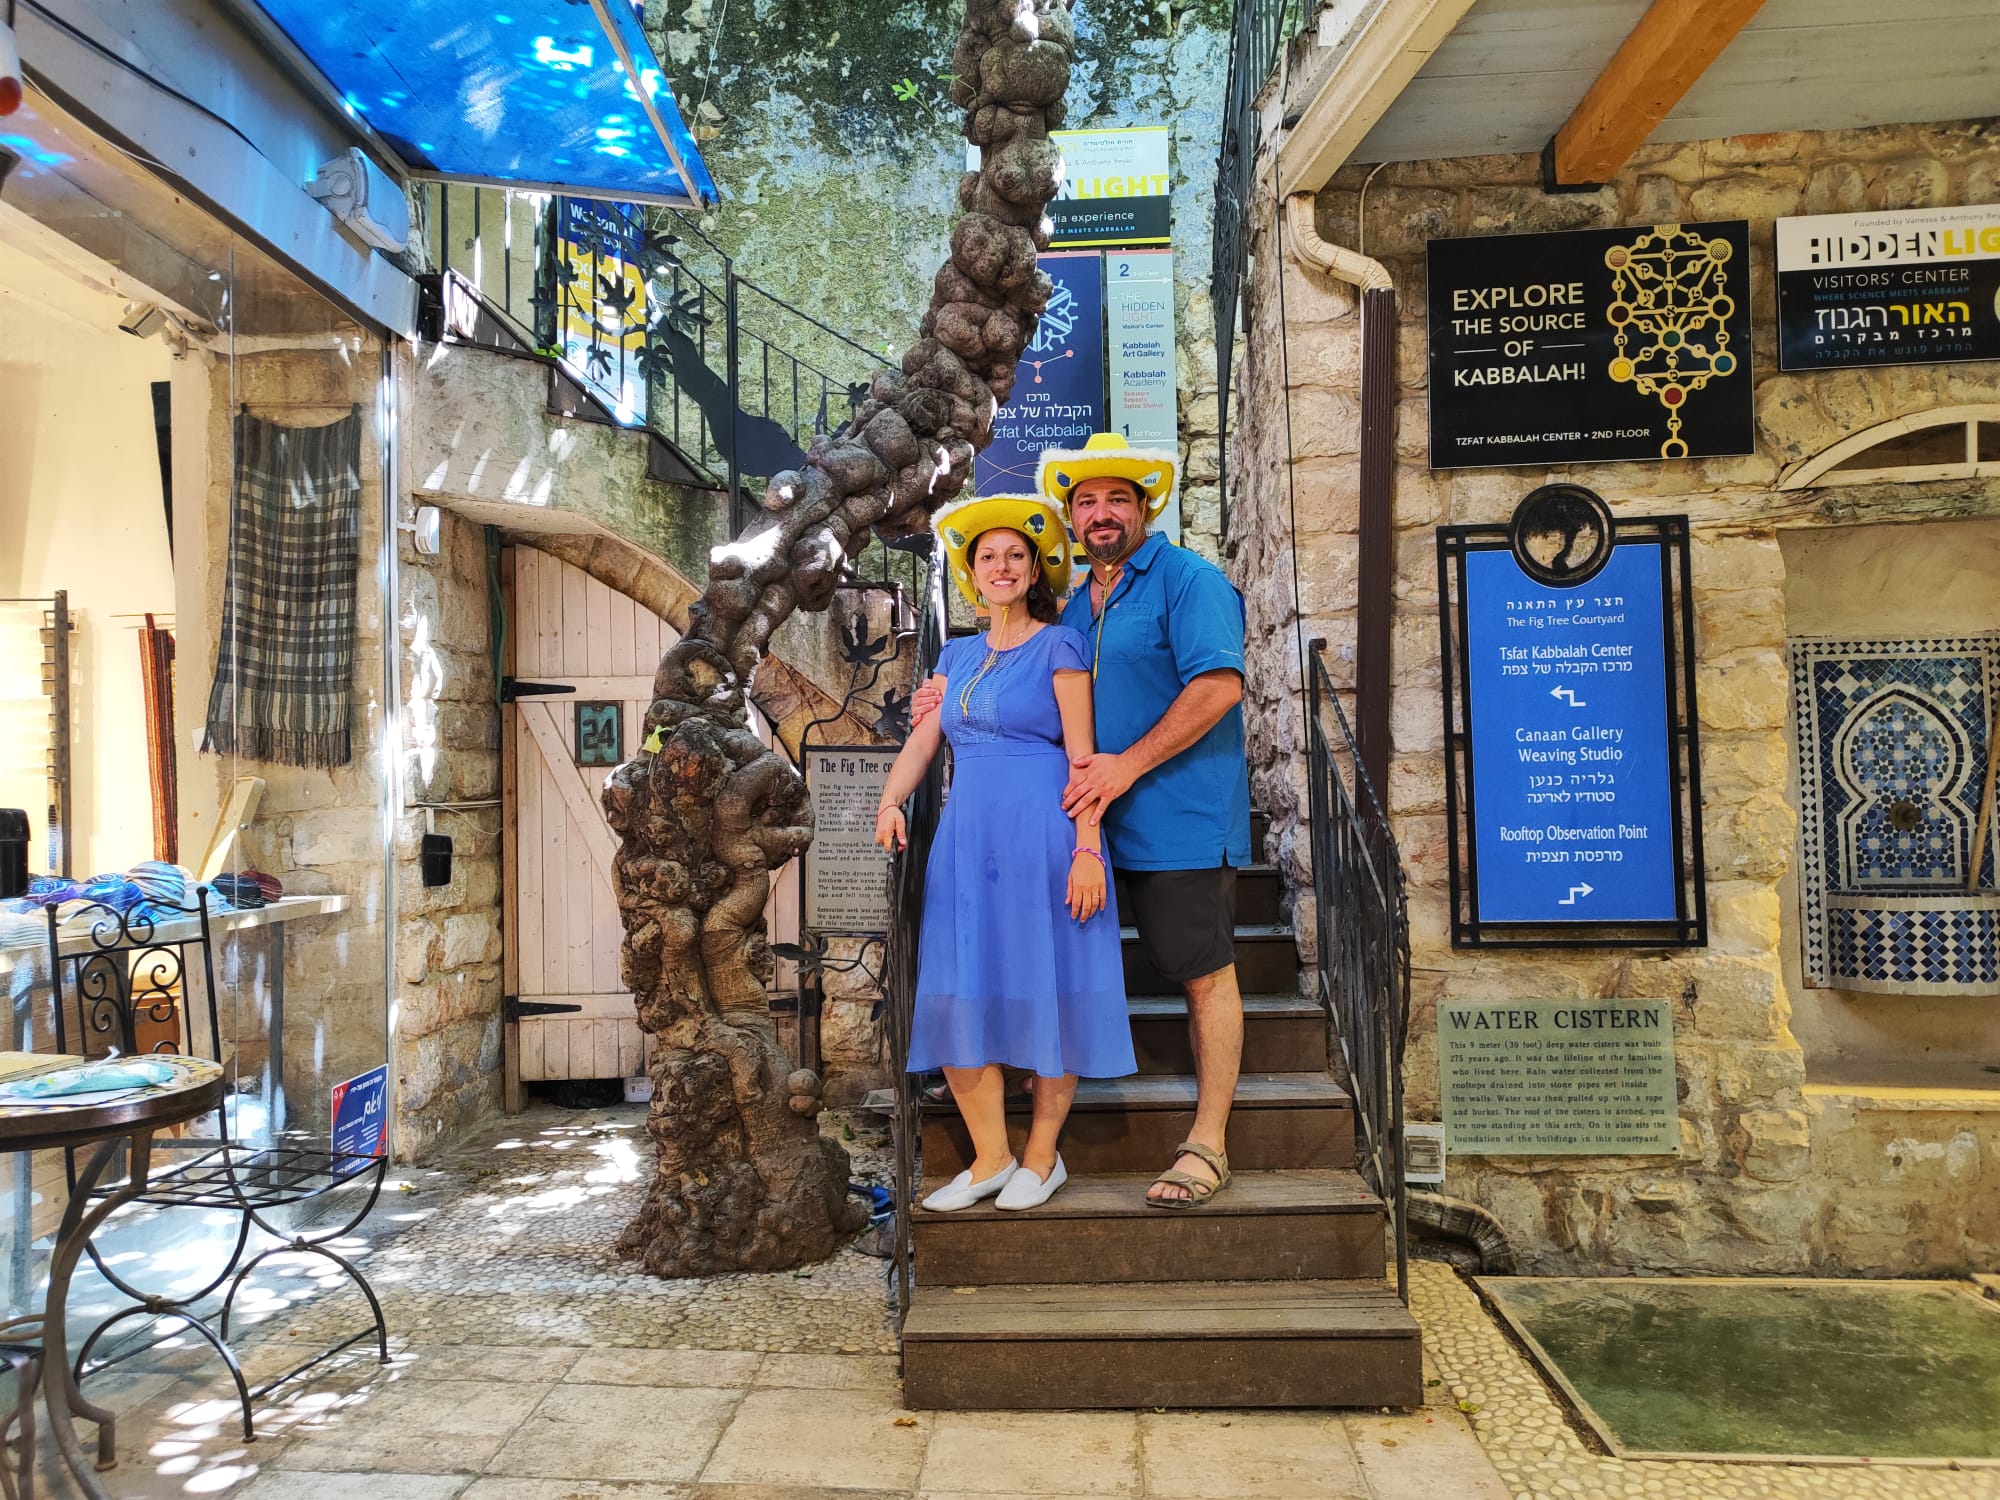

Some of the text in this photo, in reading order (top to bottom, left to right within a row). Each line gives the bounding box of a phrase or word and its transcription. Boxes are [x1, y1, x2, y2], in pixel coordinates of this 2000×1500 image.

[1071, 211, 1135, 224] experience
[1854, 219, 1891, 228] Founded
[1892, 217, 1903, 226] by
[1905, 215, 1938, 225] Vanessa
[1949, 212, 1983, 223] Anthony
[1119, 263, 1130, 277] 2
[1901, 268, 1969, 284] CENTER
[1452, 282, 1585, 312] EXPLORE
[1814, 286, 1970, 302] WHERE SCIENCE MEETS KABBALAH
[1121, 301, 1165, 312] HIDDEN
[1122, 312, 1156, 322] LIGHT
[1451, 312, 1586, 336] THE SOURCE
[1814, 327, 1973, 345] מרכז מבקרים
[1122, 341, 1161, 350] Kabbalah
[1503, 340, 1534, 358] OF
[1122, 349, 1165, 358] Art Gallery
[1815, 348, 1861, 360] הקבלה
[1123, 369, 1166, 379] Kabbalah
[1454, 362, 1586, 387] KABBALAH!
[1123, 378, 1167, 388] Academy
[1025, 392, 1051, 402] מרכז
[994, 403, 1092, 421] הקבלה של צפ
[992, 422, 1093, 439] zfat Kabbalah
[1122, 423, 1130, 438] 1
[1456, 428, 1650, 446] TZFAT KABBALAH CENTER 2ND FLOOR
[1506, 596, 1624, 611] חצר עץ התאנה
[1506, 613, 1625, 629] The Fig Tree Courtyard
[1499, 643, 1634, 661] Tsfat Kabbalah Center
[1501, 660, 1634, 677] מרכז הקבלה של צפת
[582, 718, 616, 750] 24
[1515, 725, 1624, 744] Canaan Gallery
[1517, 746, 1624, 766] Weaving Studio
[819, 758, 837, 773] The
[840, 758, 855, 777] Fig
[858, 758, 879, 773] Tree
[1529, 771, 1615, 790] גלריה כנען
[1527, 789, 1616, 804] סטודיו לאריגה
[1499, 824, 1649, 845] Rooftop Observation Point
[1525, 850, 1624, 863] מרפסת תצפית
[1449, 1009, 1660, 1030] WATER CISTERN
[1449, 1041, 1466, 1049] This
[1478, 1041, 1501, 1049] meter
[1546, 1041, 1565, 1050] deep
[1568, 1041, 1590, 1049] water
[1593, 1040, 1620, 1049] cistern
[1642, 1039, 1662, 1048] built
[1468, 1055, 1491, 1064] years
[1546, 1054, 1560, 1062] the
[1563, 1053, 1594, 1062] lifeline
[1610, 1053, 1624, 1061] the
[1628, 1053, 1662, 1061] families
[1451, 1067, 1470, 1076] who
[1474, 1067, 1496, 1076] lived
[1526, 1067, 1547, 1075] Rain
[1580, 1067, 1619, 1075] collected
[1623, 1067, 1644, 1075] from
[1648, 1066, 1663, 1075] the
[1451, 1080, 1648, 1090] rooftops drained into stone pipes inside
[1496, 1094, 1521, 1103] Water
[1568, 1094, 1594, 1103] pulled
[1613, 1094, 1631, 1102] with
[1645, 1095, 1664, 1103] rope
[1452, 1108, 1468, 1116] and
[1504, 1107, 1520, 1116] The
[1555, 1108, 1569, 1116] the
[1572, 1107, 1600, 1116] cistern
[1649, 1108, 1665, 1116] you
[1491, 1122, 1526, 1130] standing
[1588, 1121, 1600, 1129] On
[1615, 1121, 1632, 1129] also
[1653, 1121, 1667, 1129] the
[1454, 1135, 1501, 1143] foundation
[1518, 1135, 1532, 1143] the
[1536, 1135, 1577, 1144] buildings
[1595, 1135, 1612, 1143] this
